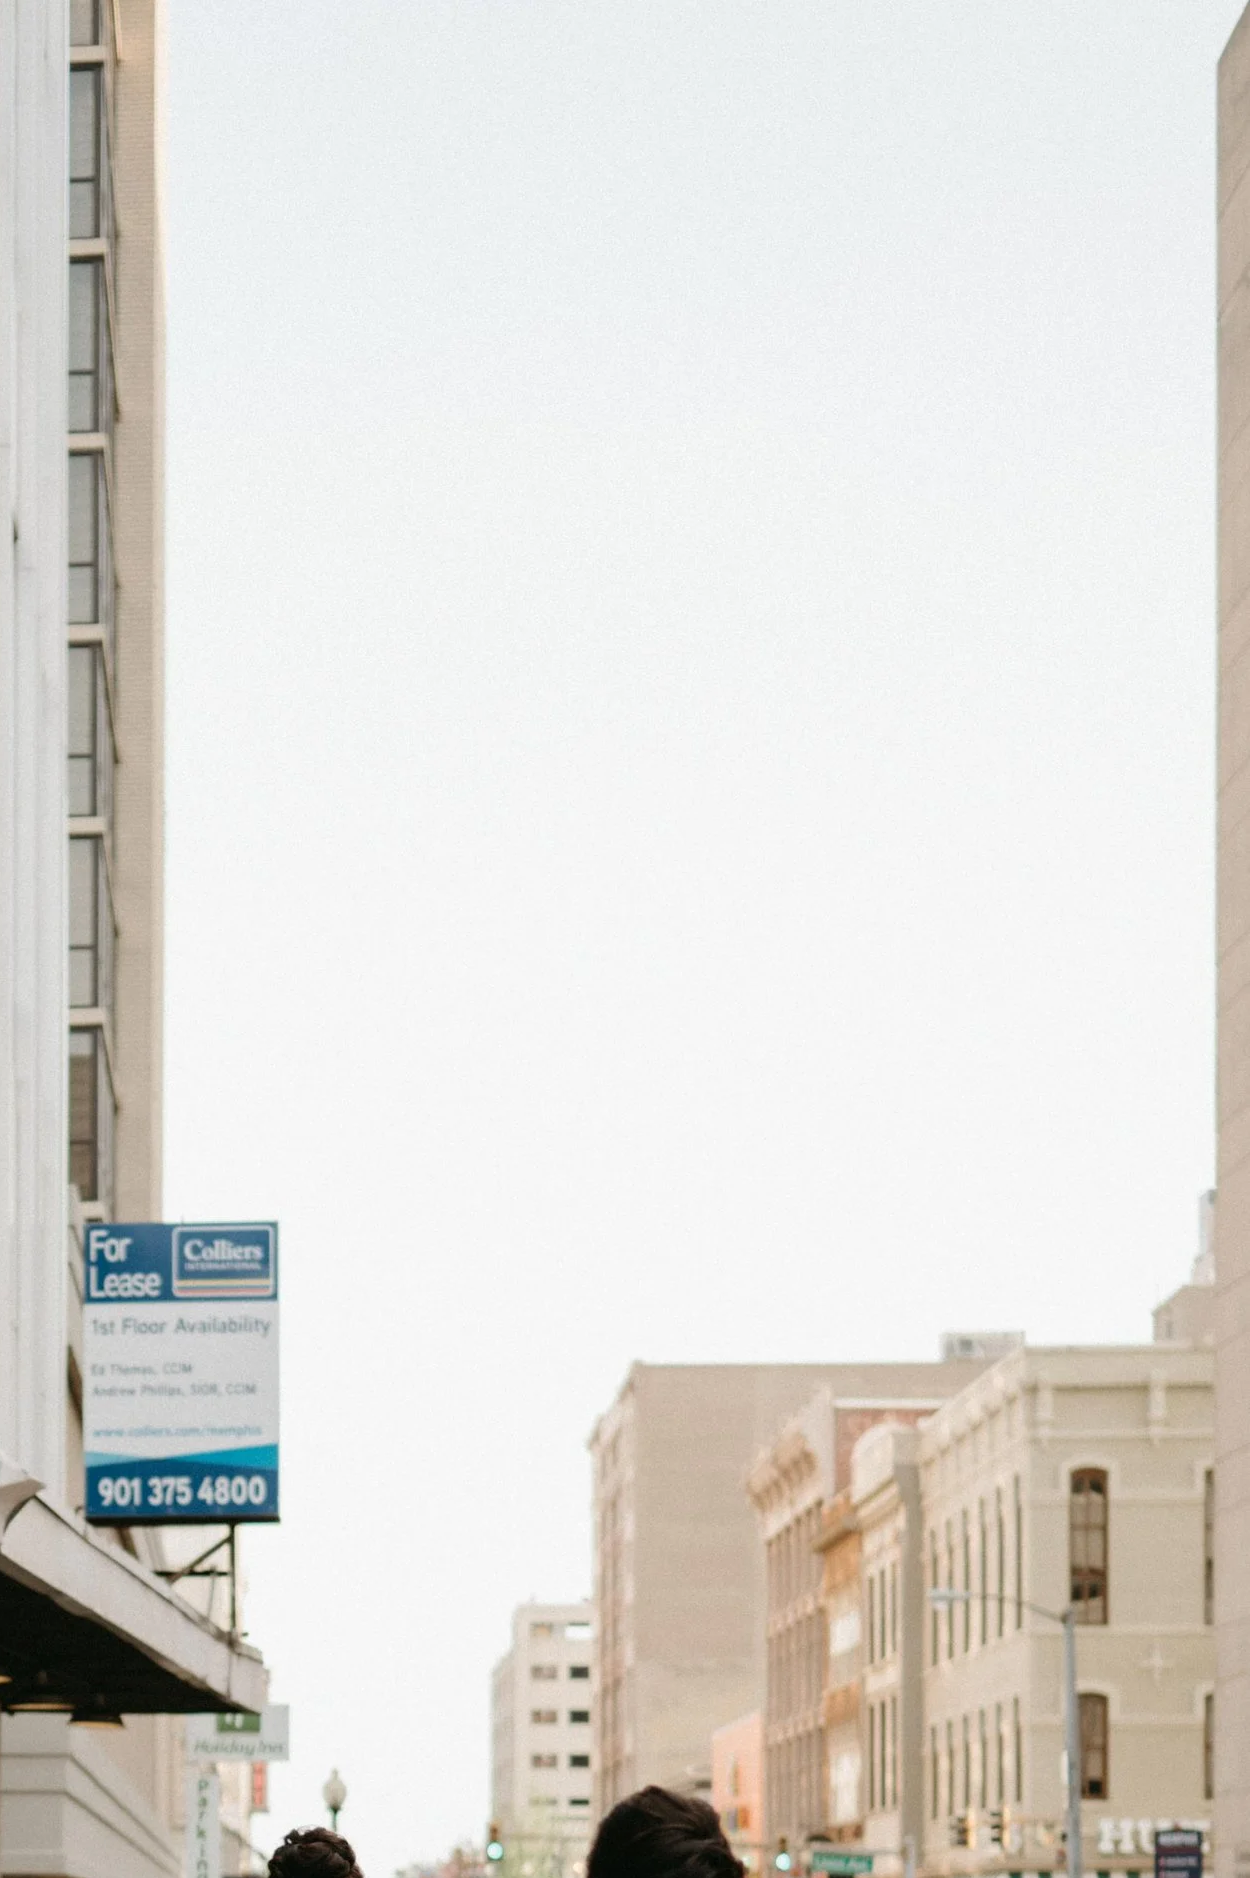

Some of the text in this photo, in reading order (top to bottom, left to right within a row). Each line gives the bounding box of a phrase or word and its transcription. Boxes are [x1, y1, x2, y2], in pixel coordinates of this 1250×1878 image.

[89, 1230, 132, 1263] For
[183, 1239, 263, 1261] Colliers
[89, 1266, 162, 1298] Lease
[92, 1316, 271, 1337] 1st Floor Availability
[93, 1385, 135, 1397] Andrew
[98, 1476, 266, 1506] 901 375 4800
[194, 1740, 284, 1756] Holiday Inn
